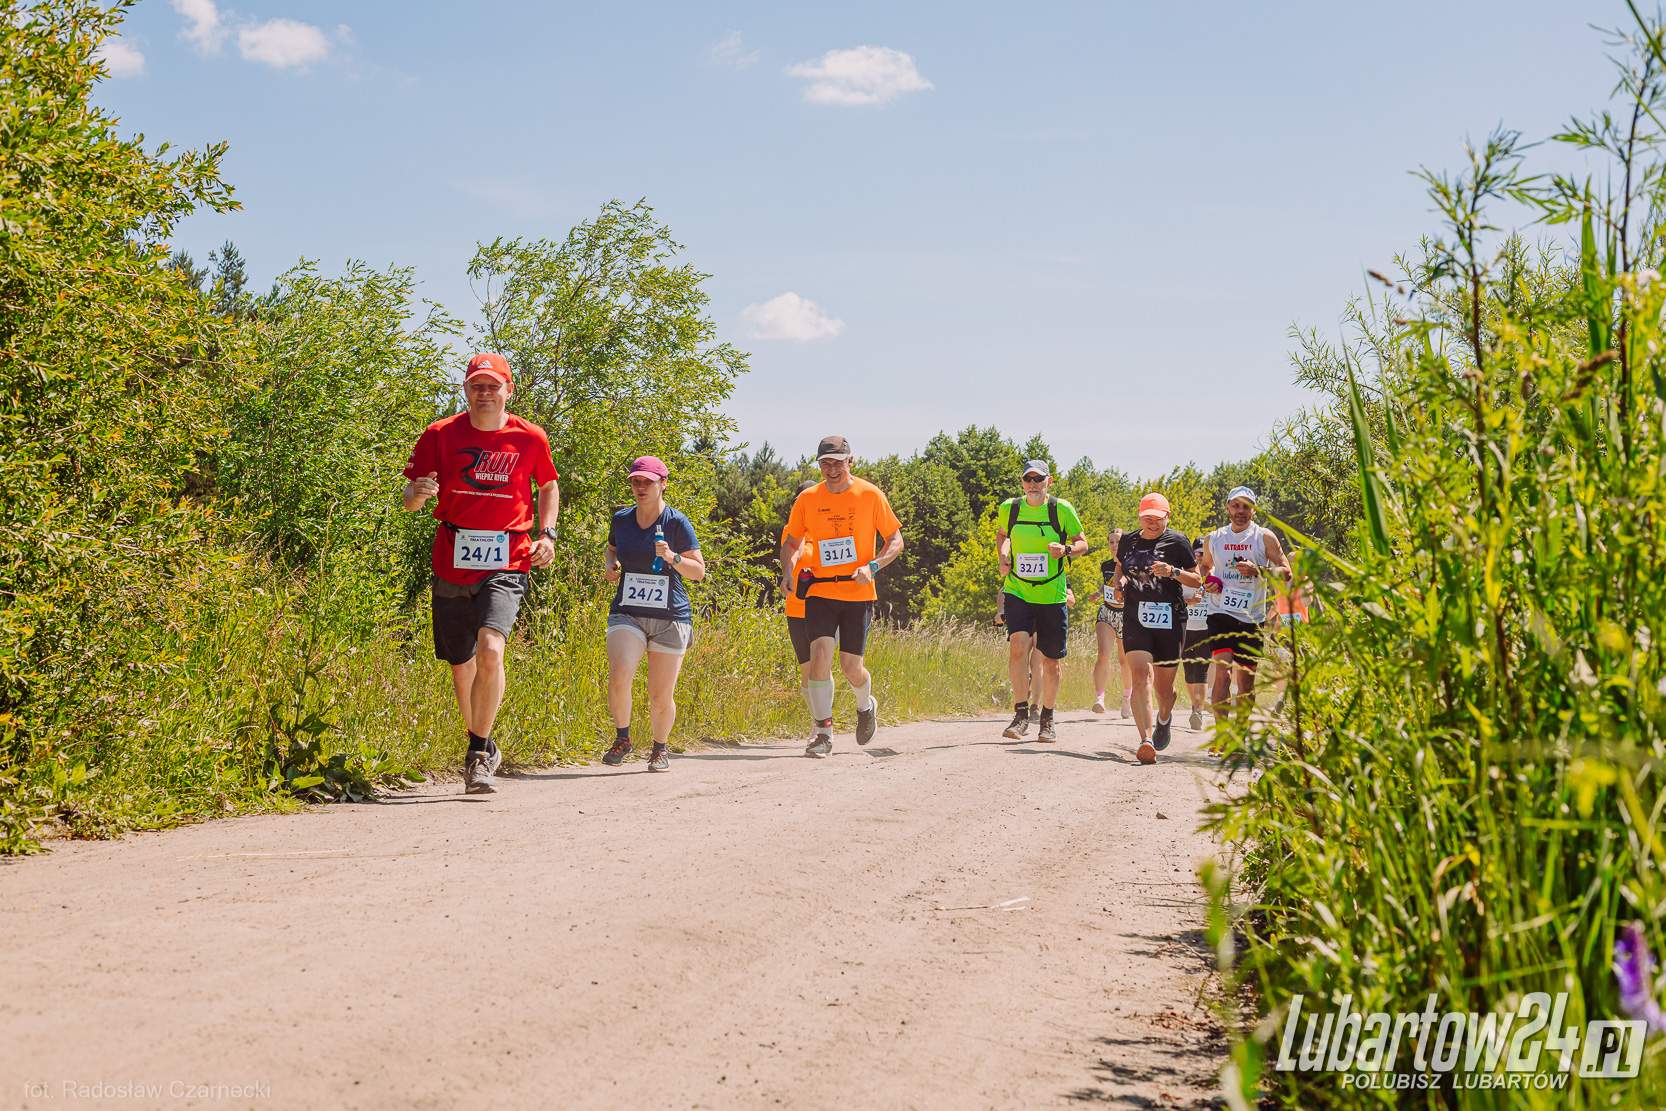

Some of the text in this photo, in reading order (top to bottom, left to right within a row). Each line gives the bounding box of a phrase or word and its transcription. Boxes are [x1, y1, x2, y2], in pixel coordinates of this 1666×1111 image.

[474, 450, 520, 475] RUN
[475, 472, 509, 482] WIEPRZ RIVER
[461, 546, 503, 562] 24/1
[824, 547, 853, 561] 31/1
[1020, 563, 1045, 573] 32/1
[628, 586, 663, 602] 24/2
[1223, 595, 1249, 609] 35/1
[1142, 611, 1169, 624] 32/2
